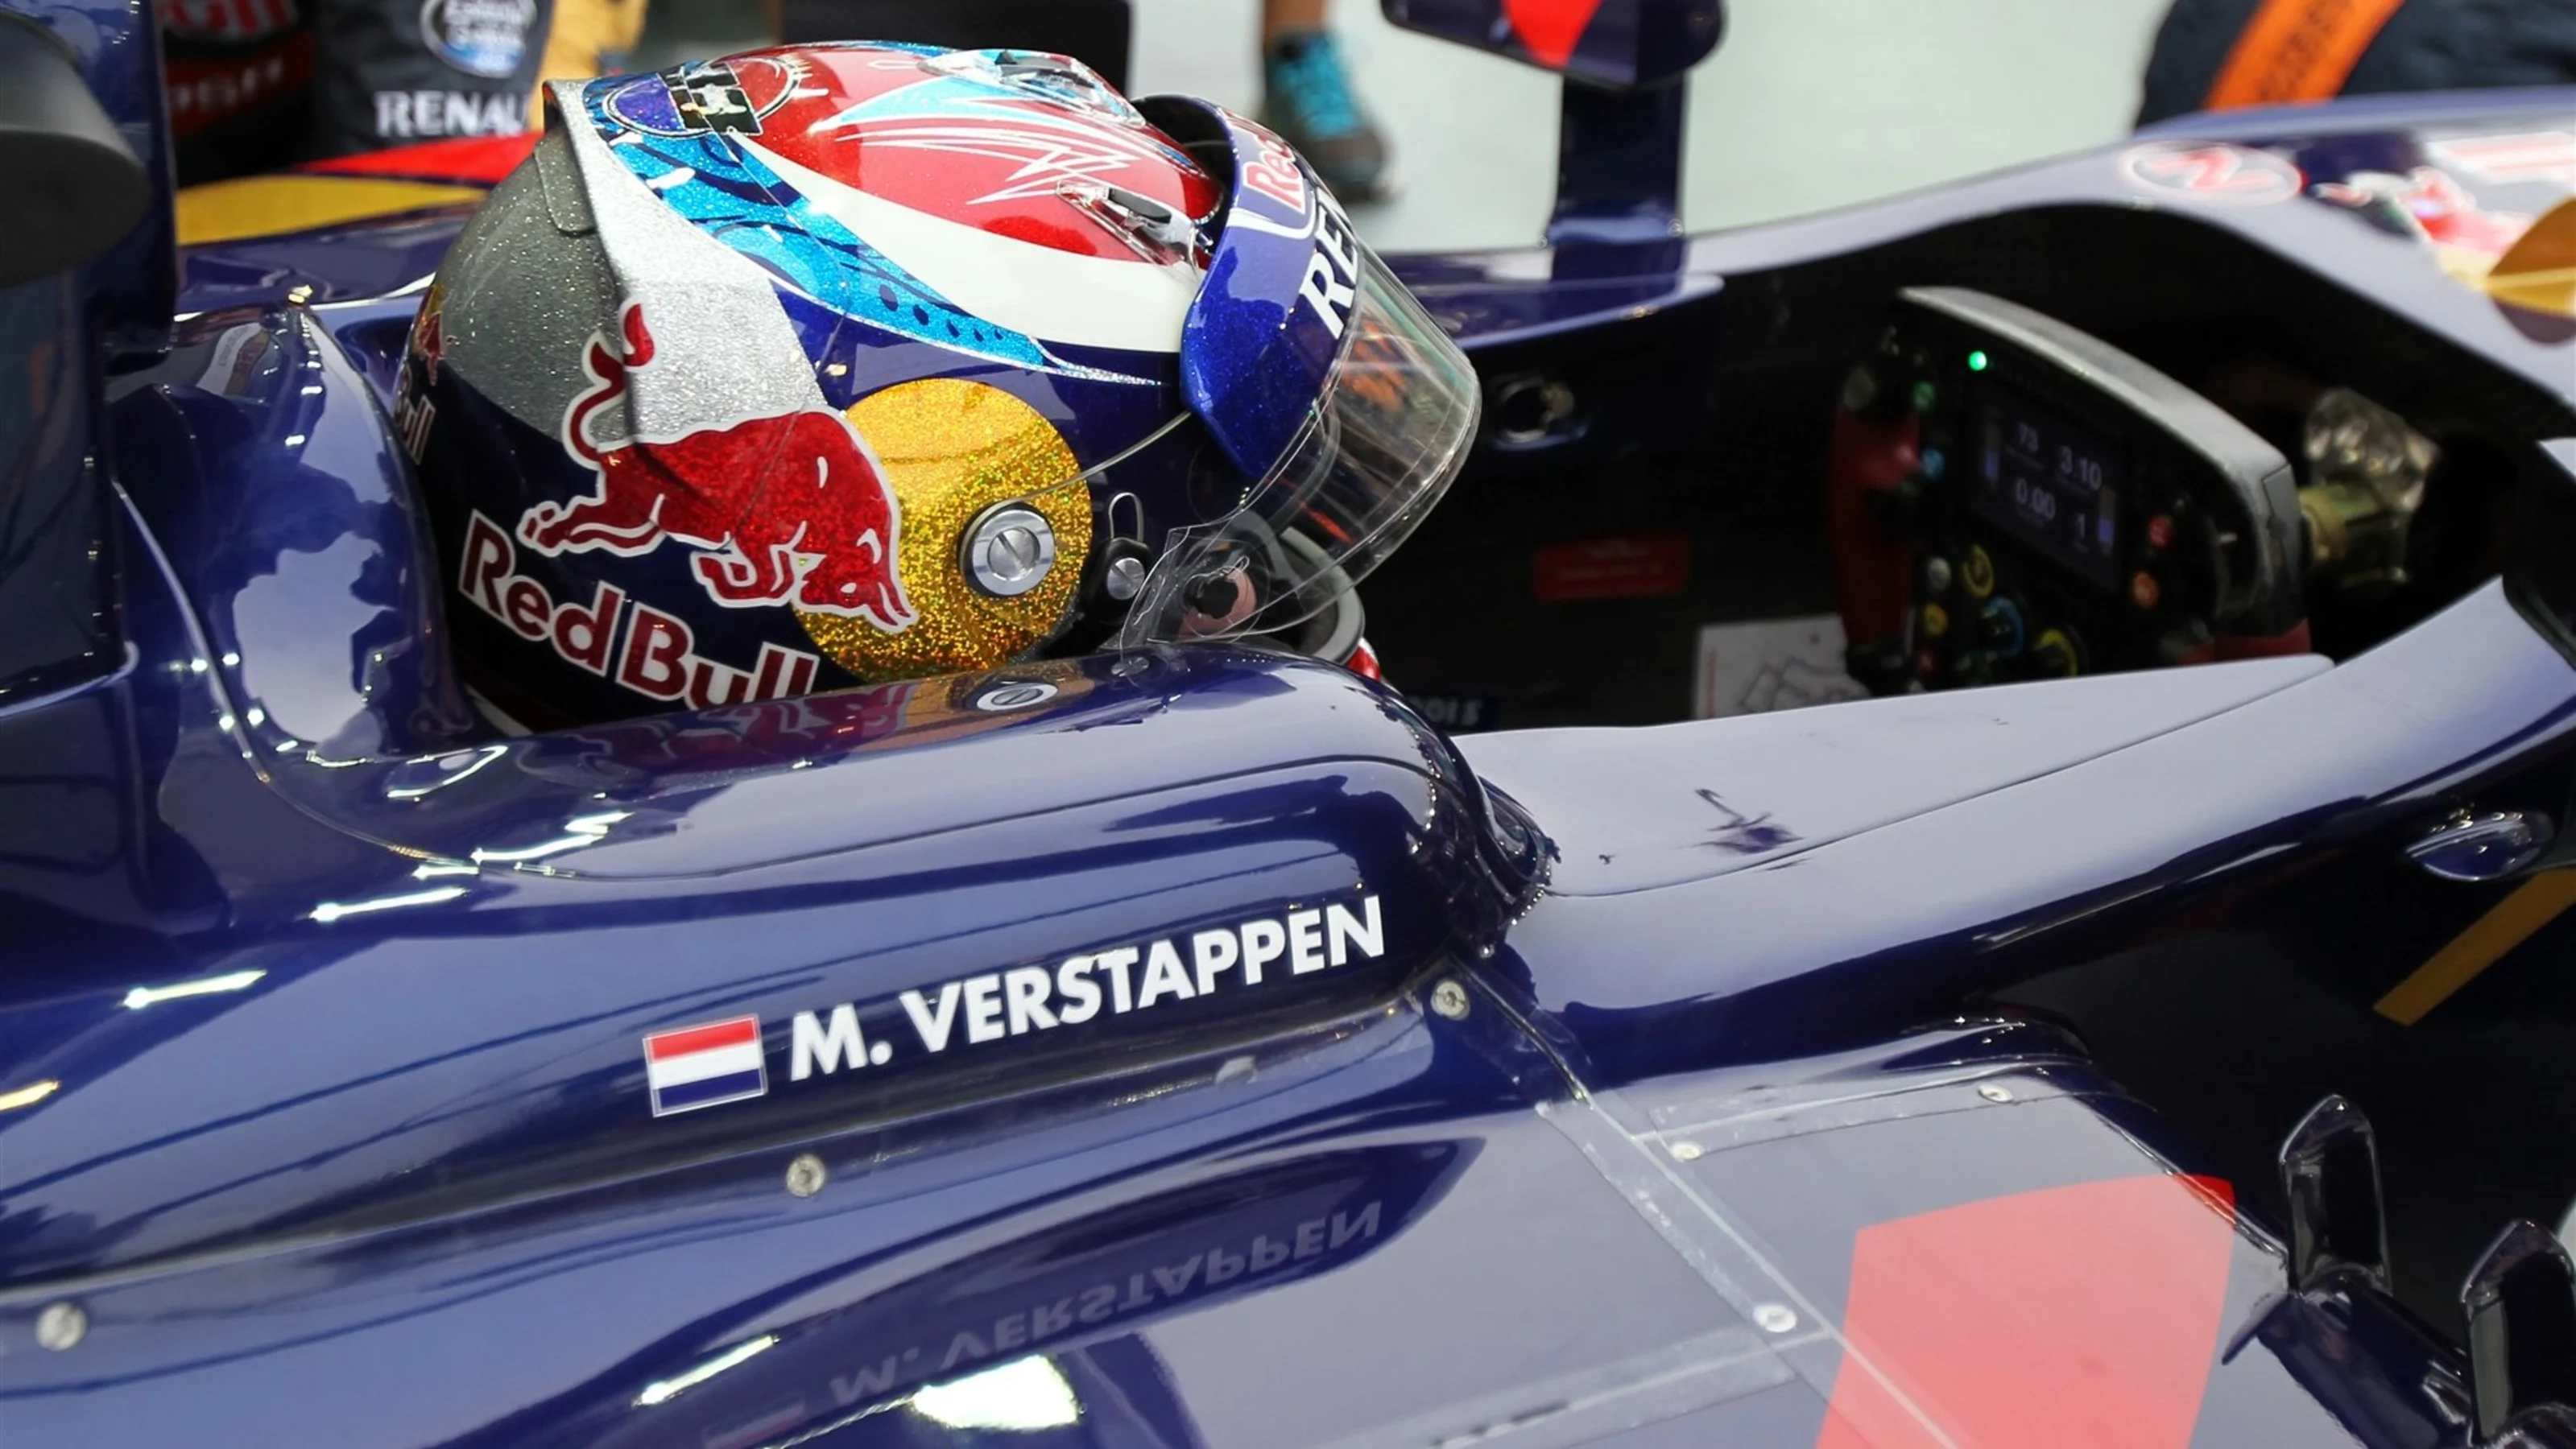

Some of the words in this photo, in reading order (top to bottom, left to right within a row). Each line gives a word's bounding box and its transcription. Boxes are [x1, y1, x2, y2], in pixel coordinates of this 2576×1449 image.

[2013, 476, 2057, 521] 0.00
[458, 509, 626, 676] Red
[615, 601, 820, 710] Bull
[789, 1003, 894, 1082] M.
[899, 894, 1386, 1055] VERSTAPPEN
